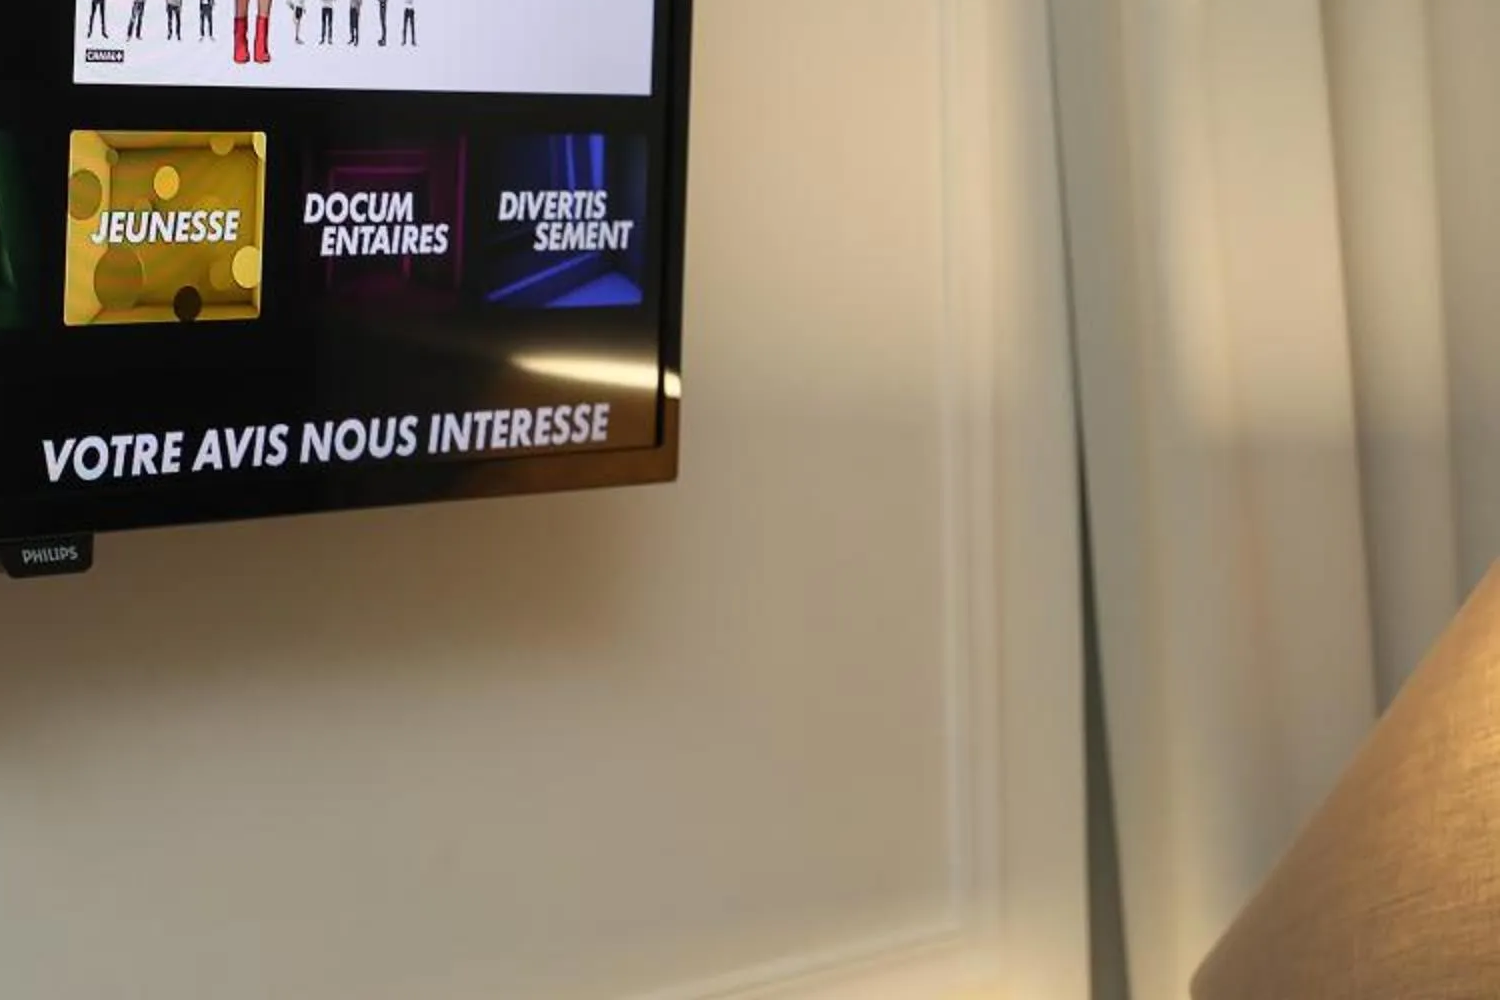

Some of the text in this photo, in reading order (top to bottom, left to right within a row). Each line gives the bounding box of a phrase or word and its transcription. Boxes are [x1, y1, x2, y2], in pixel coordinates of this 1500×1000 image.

[303, 191, 414, 224] DOCUM
[498, 190, 608, 221] DIVERTIS
[91, 210, 240, 244] JEUNESSE
[320, 223, 450, 257] ENTAIRES
[533, 220, 634, 251] SEMENT
[41, 402, 611, 483] VOTRE AVIS NOUS INTERESSE
[21, 545, 79, 564] PHILIPS
